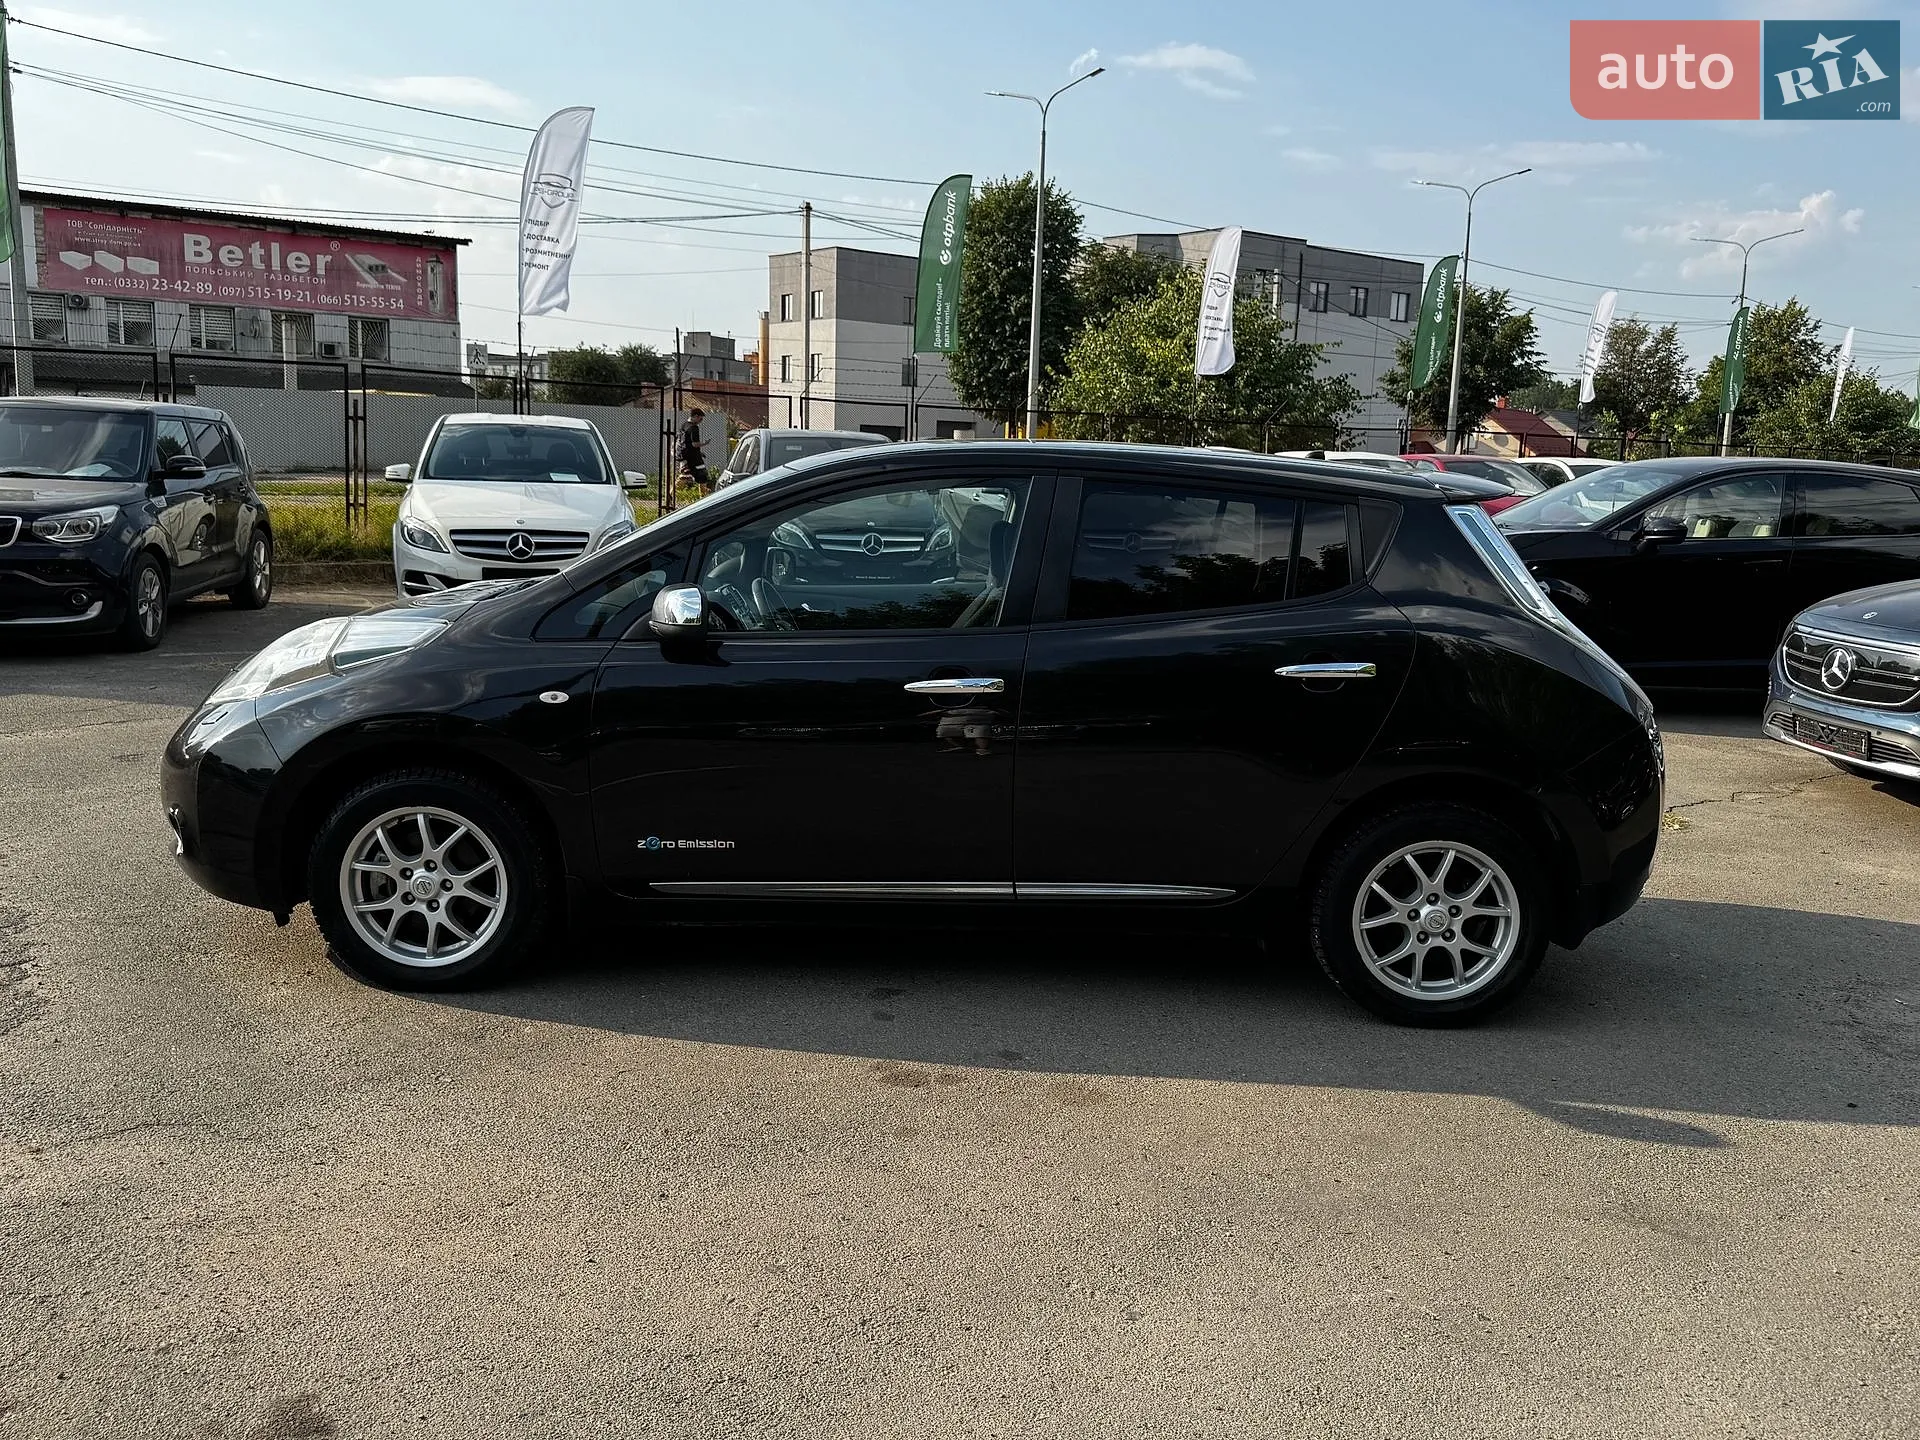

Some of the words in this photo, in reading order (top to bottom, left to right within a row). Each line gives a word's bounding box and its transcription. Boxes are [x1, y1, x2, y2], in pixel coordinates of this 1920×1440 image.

[66, 219, 83, 228] ТОВ
[943, 190, 956, 247] otpbank
[526, 233, 560, 244] ДОСТАВКА
[524, 262, 549, 271] РЕМОНТ
[185, 265, 254, 279] ПОЛЬСЬКИЙ
[263, 272, 326, 285] ГАЗОБЕТОН
[84, 276, 112, 287] тел.:
[114, 277, 149, 290] (0332)
[218, 285, 245, 298] (097)
[317, 294, 341, 306] (066)
[344, 294, 404, 310] 515-55-54
[1436, 267, 1447, 309] otpbank
[678, 839, 735, 849] Emission
